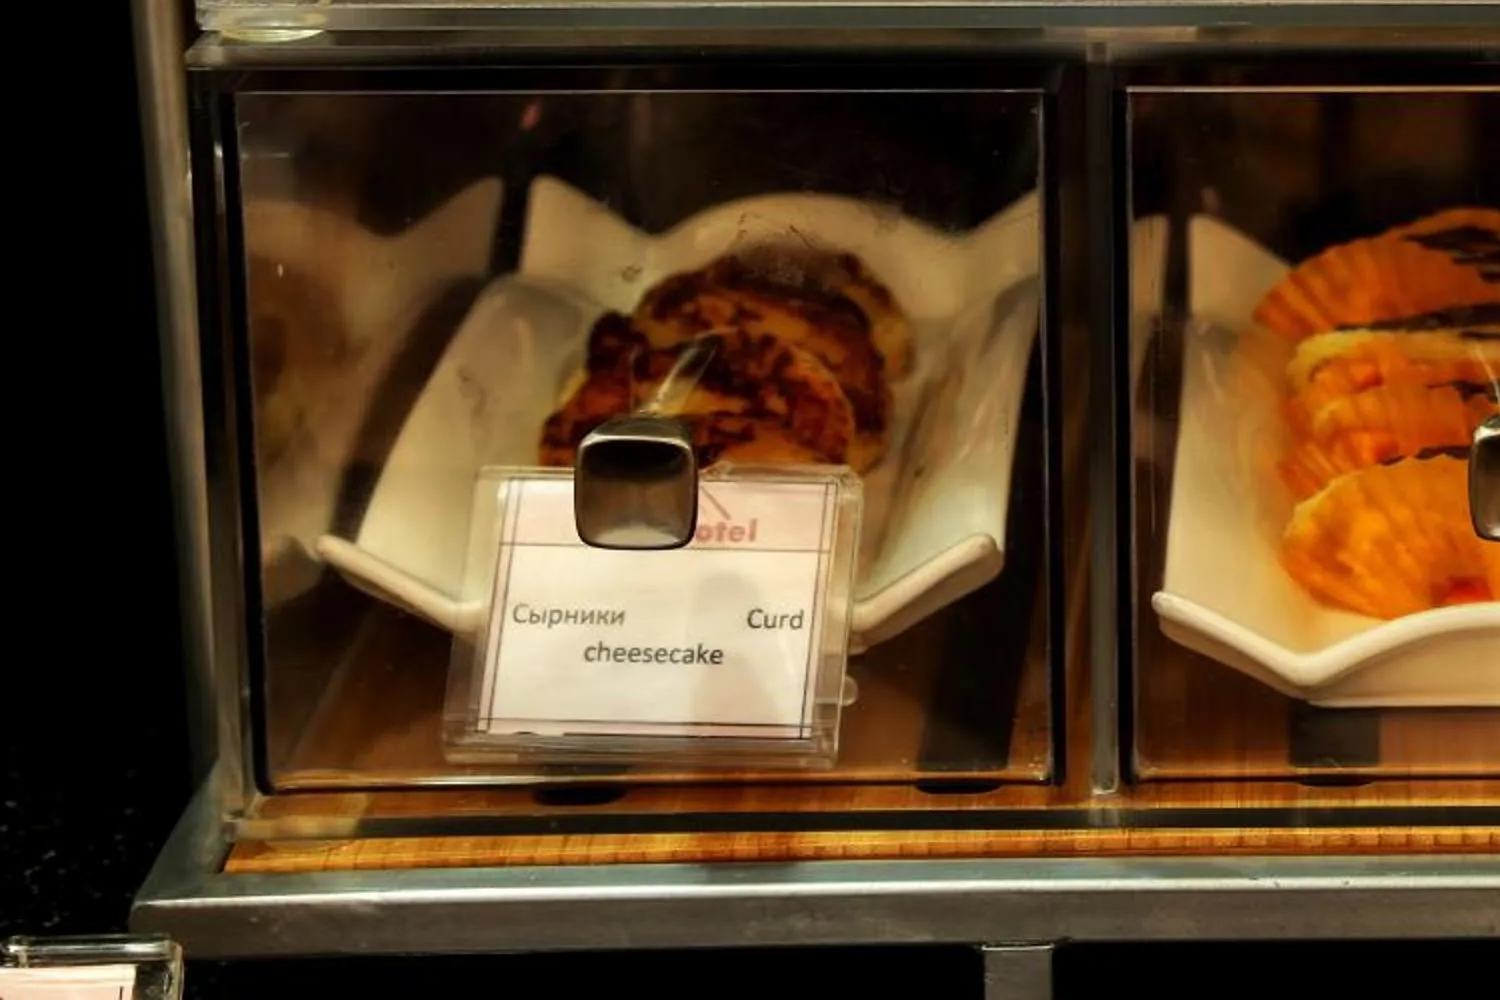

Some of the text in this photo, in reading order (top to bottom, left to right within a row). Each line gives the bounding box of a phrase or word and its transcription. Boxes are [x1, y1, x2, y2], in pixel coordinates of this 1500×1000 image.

[695, 518, 758, 542] otel
[512, 603, 804, 629] Сырники Curd
[584, 641, 724, 665] cheesecake
